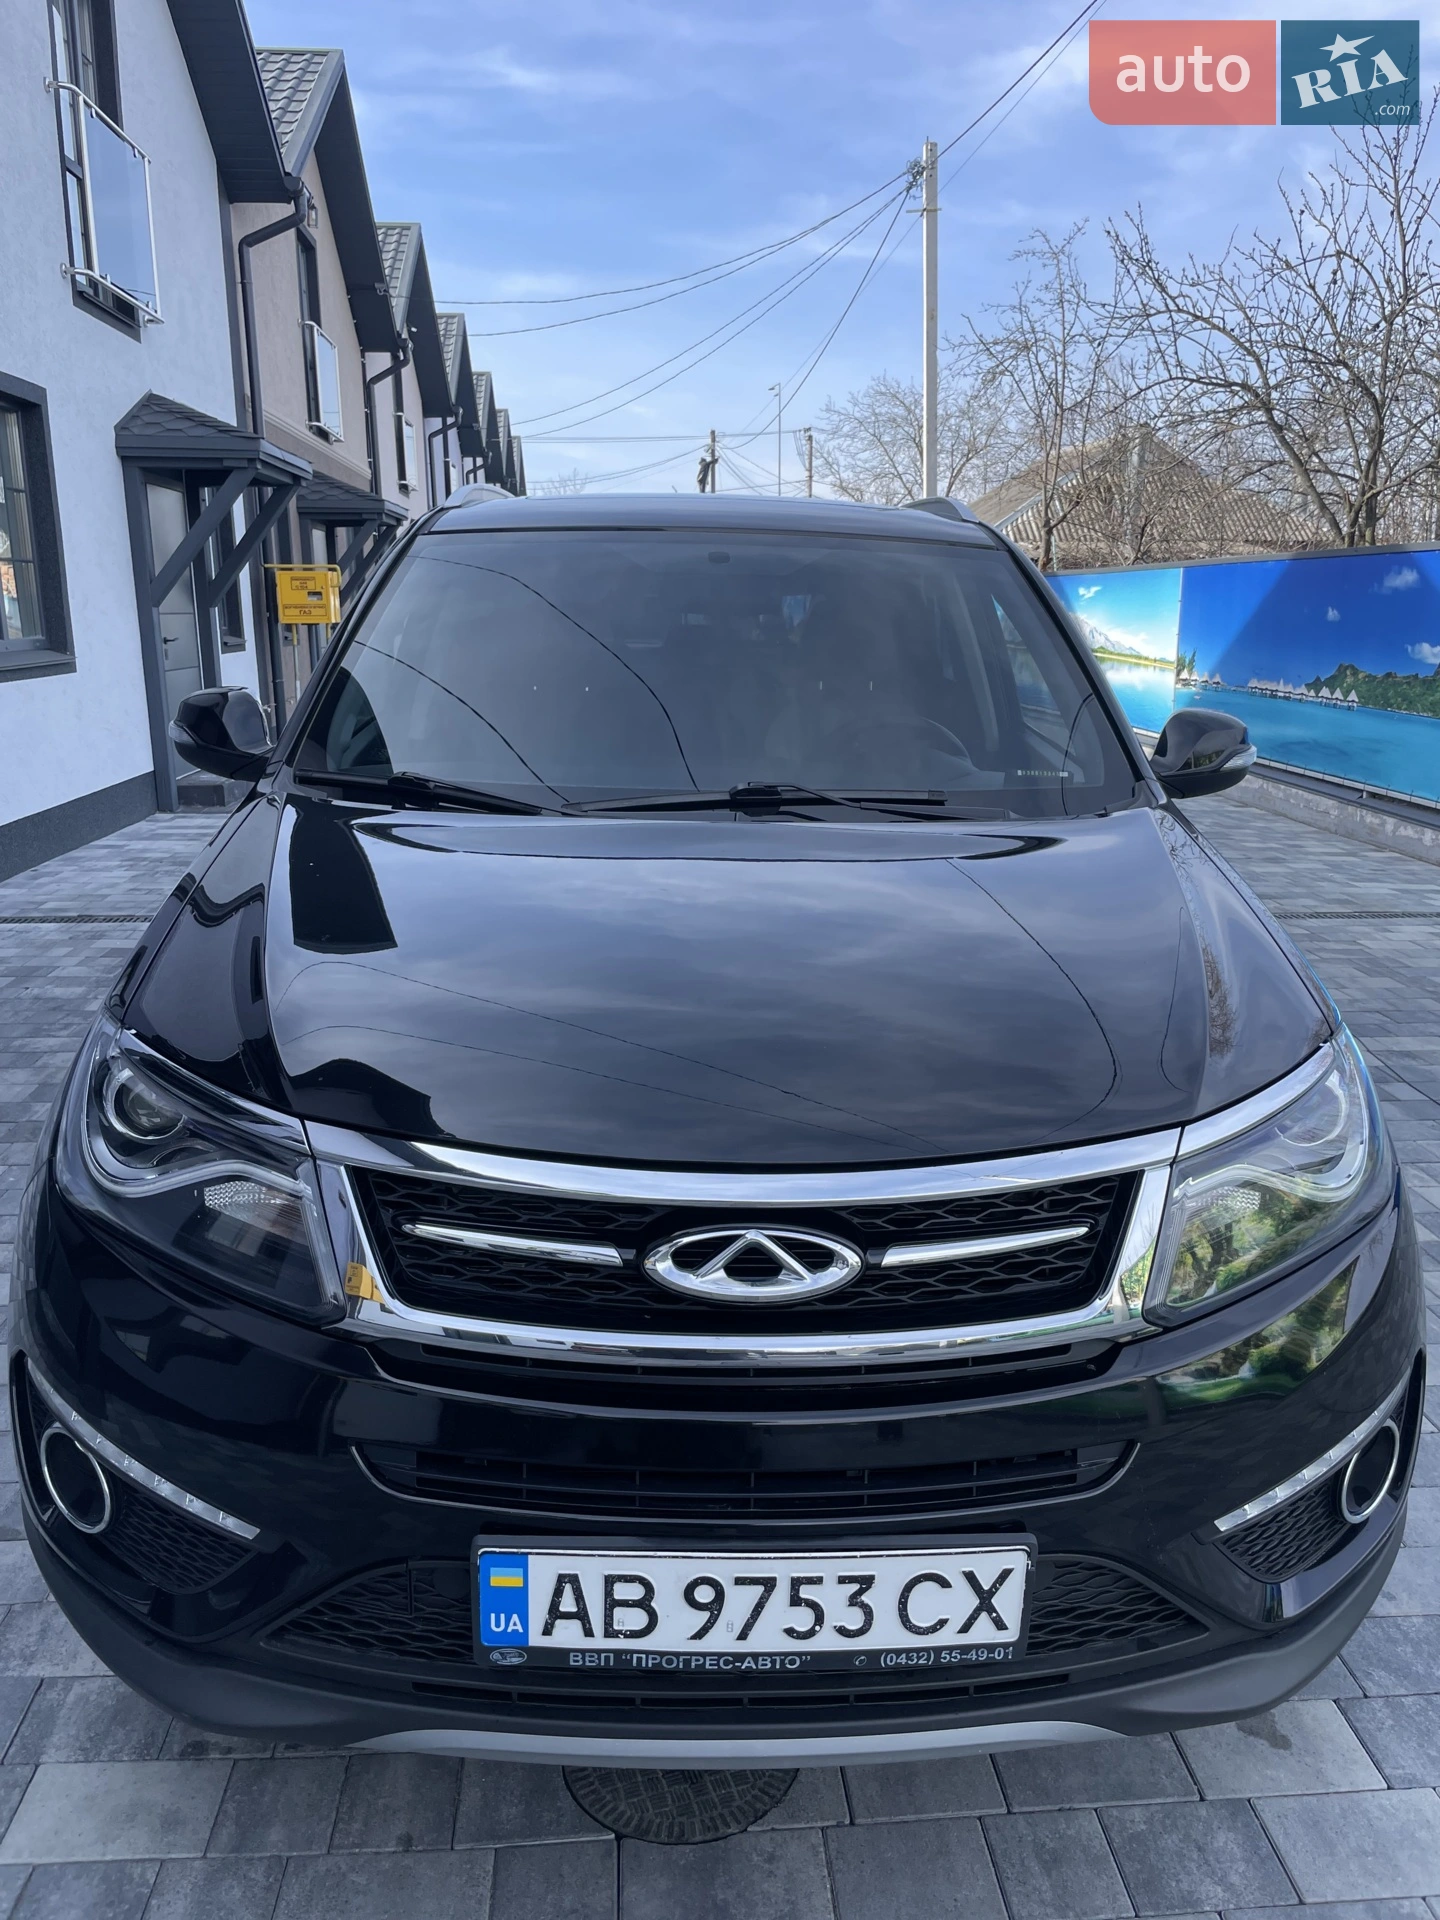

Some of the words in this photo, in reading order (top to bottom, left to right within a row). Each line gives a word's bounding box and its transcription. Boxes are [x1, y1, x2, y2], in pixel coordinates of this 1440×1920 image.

[541, 1573, 659, 1639] AB
[683, 1574, 876, 1641] 9753
[898, 1568, 1015, 1636] CX
[490, 1613, 523, 1633] UA
[569, 1652, 614, 1667] ВВП
[880, 1650, 935, 1667] (0432)
[940, 1646, 1014, 1663] 55-49-01
